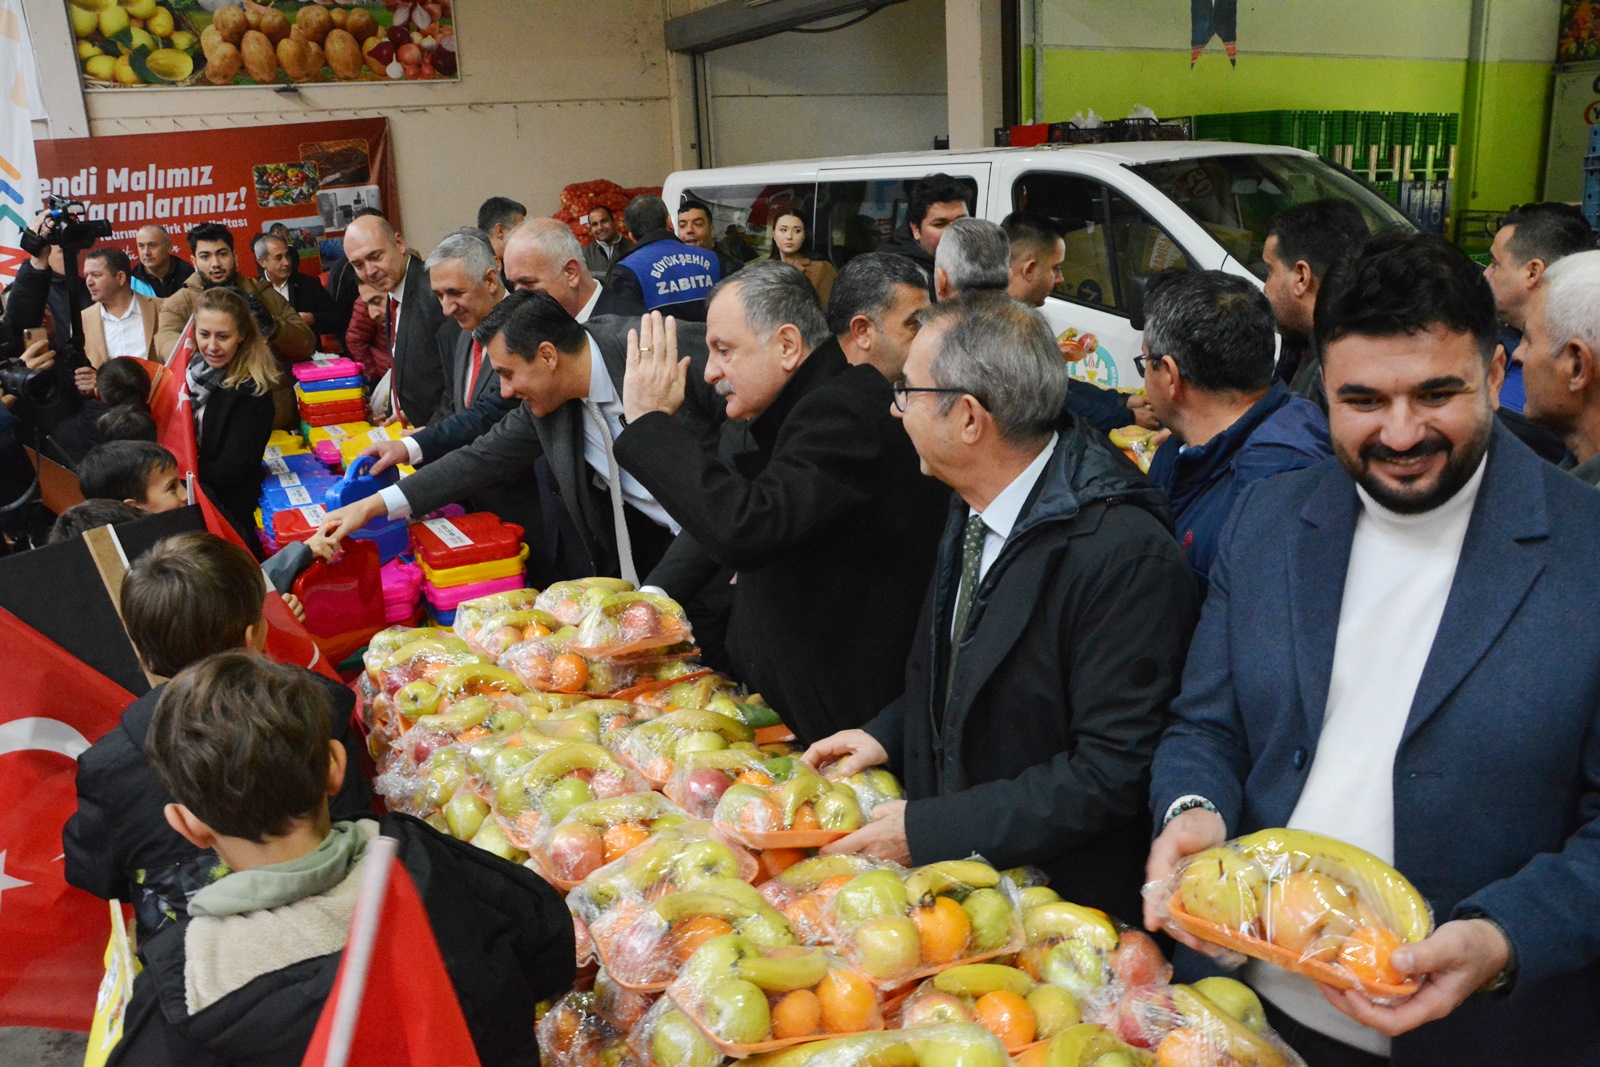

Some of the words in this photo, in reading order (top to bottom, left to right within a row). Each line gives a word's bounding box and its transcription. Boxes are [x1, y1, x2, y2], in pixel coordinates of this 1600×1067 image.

[38, 166, 97, 199] endi
[107, 163, 213, 193] Malımız
[655, 274, 713, 295] ZABITA
